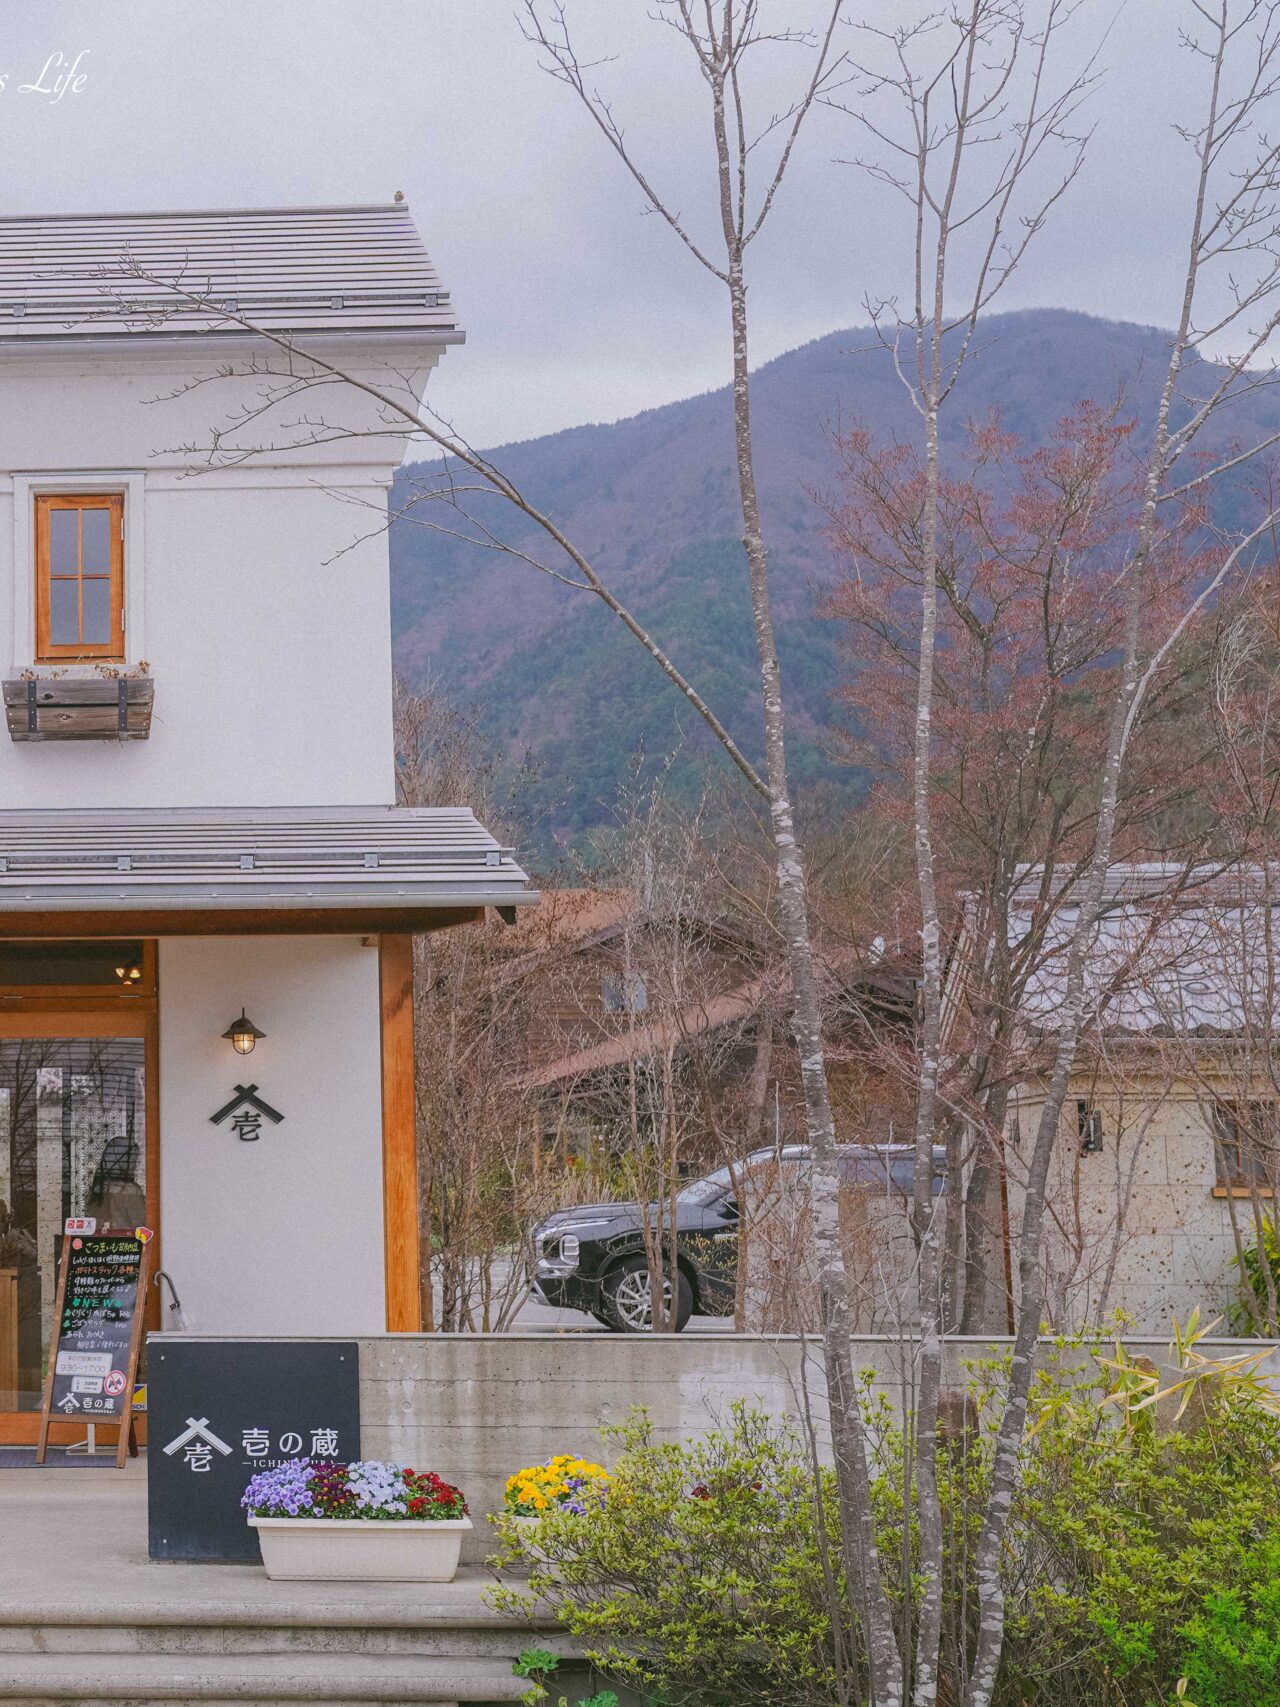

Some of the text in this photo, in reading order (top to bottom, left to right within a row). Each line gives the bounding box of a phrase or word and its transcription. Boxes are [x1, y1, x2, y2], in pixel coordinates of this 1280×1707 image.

[231, 1110, 262, 1141] 壱
[82, 1298, 113, 1308] NEW
[82, 1397, 115, 1409] 壱の蔵
[183, 1442, 213, 1472] 壱
[241, 1427, 339, 1457] 壱の蔵
